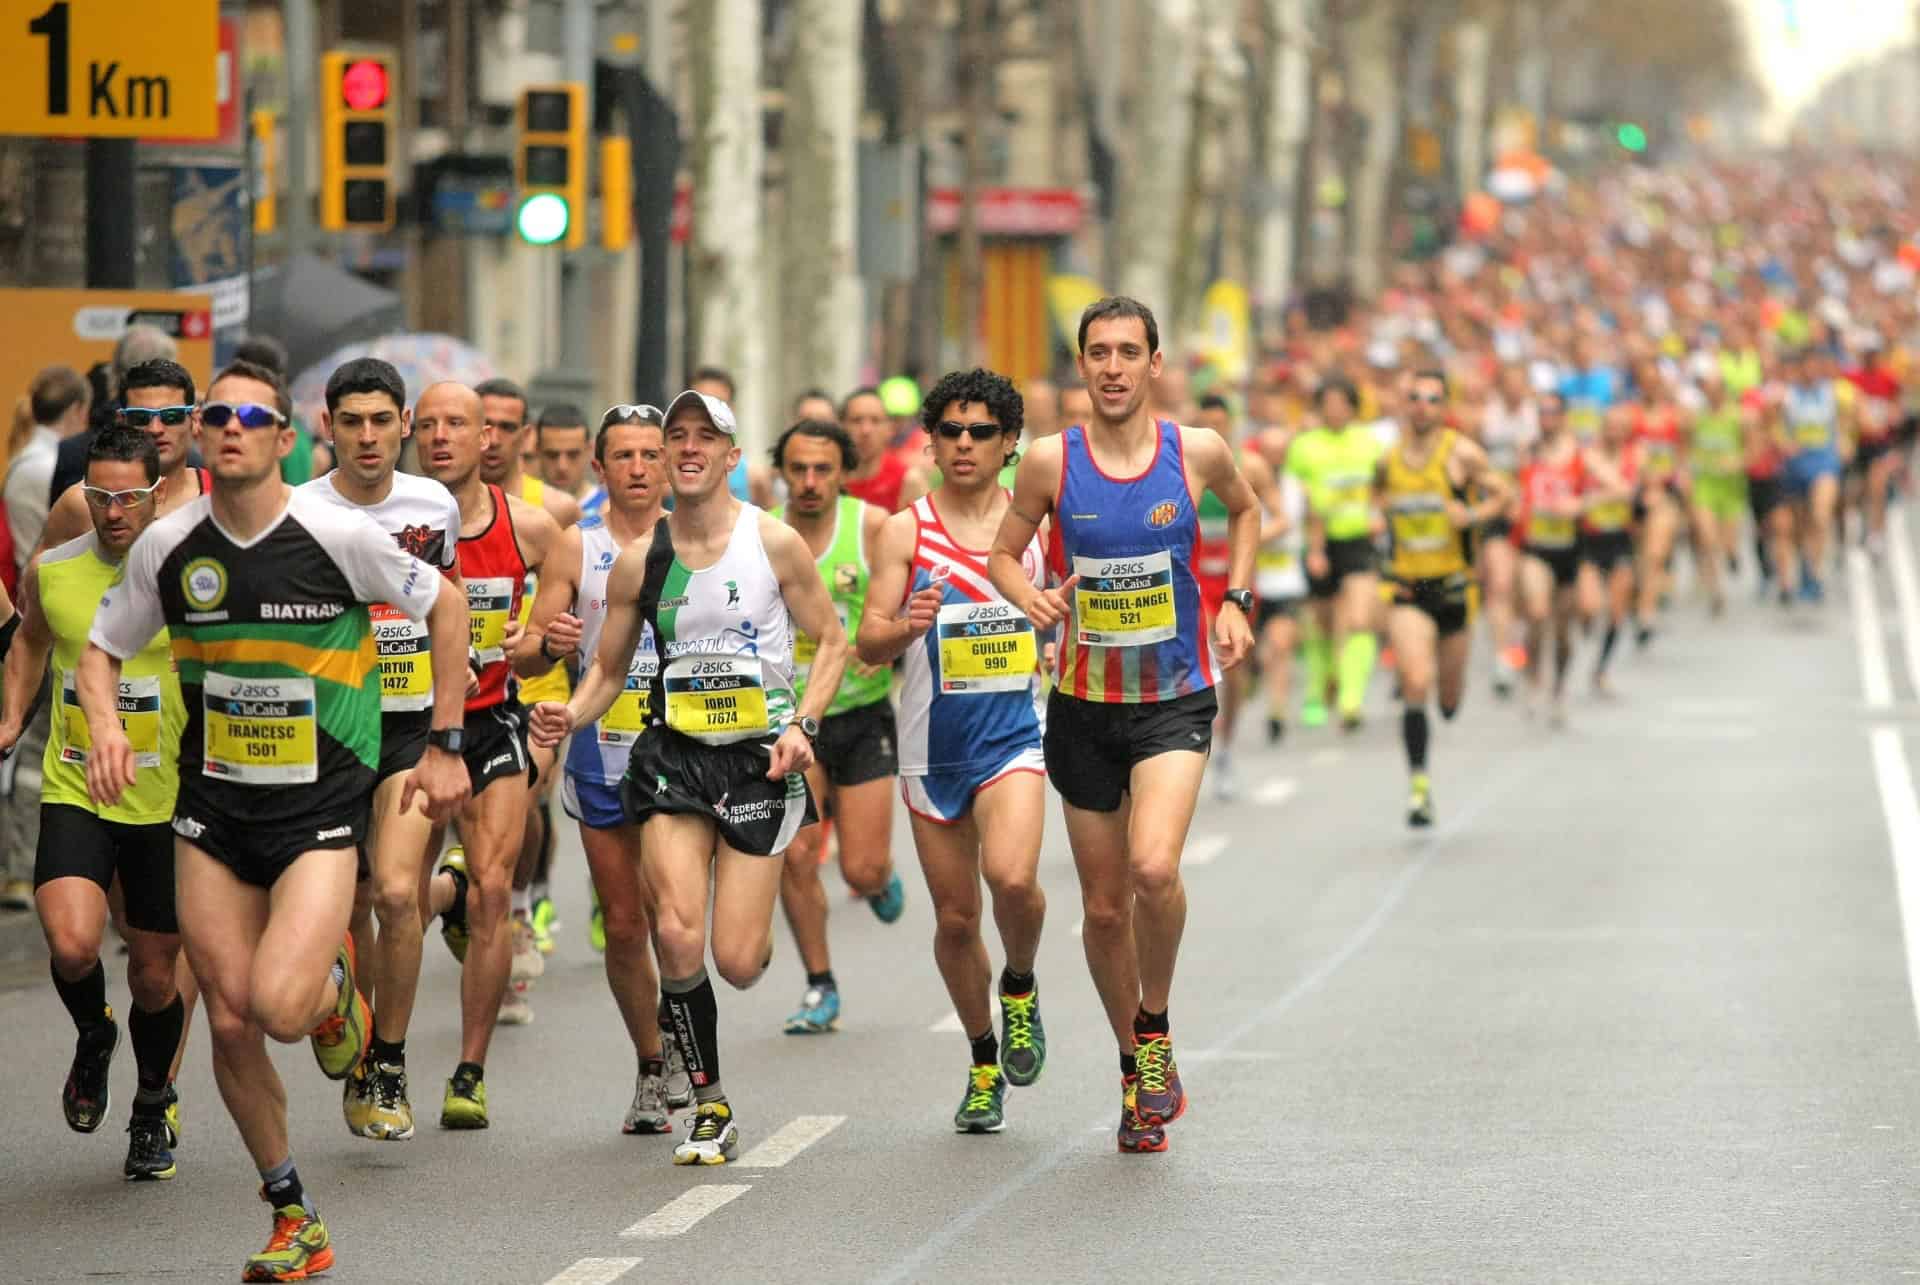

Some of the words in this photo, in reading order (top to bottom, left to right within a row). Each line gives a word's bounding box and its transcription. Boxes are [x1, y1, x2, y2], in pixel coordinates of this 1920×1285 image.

[28, 1, 69, 116] 1
[89, 61, 169, 118] Km
[1112, 563, 1144, 575] asics
[465, 584, 488, 594] sics
[1089, 592, 1168, 610] MIGUEL-ANGEL
[980, 606, 1009, 619] asics
[1120, 613, 1141, 625] 521
[380, 625, 412, 638] asics
[972, 641, 1017, 655] GUILLEM
[702, 661, 733, 674] asics
[984, 657, 1007, 669] 990
[383, 677, 408, 689] 1472
[243, 685, 280, 698] asics
[706, 711, 738, 725] 17674
[227, 723, 295, 740] FRANCESC
[246, 743, 277, 757] 1501
